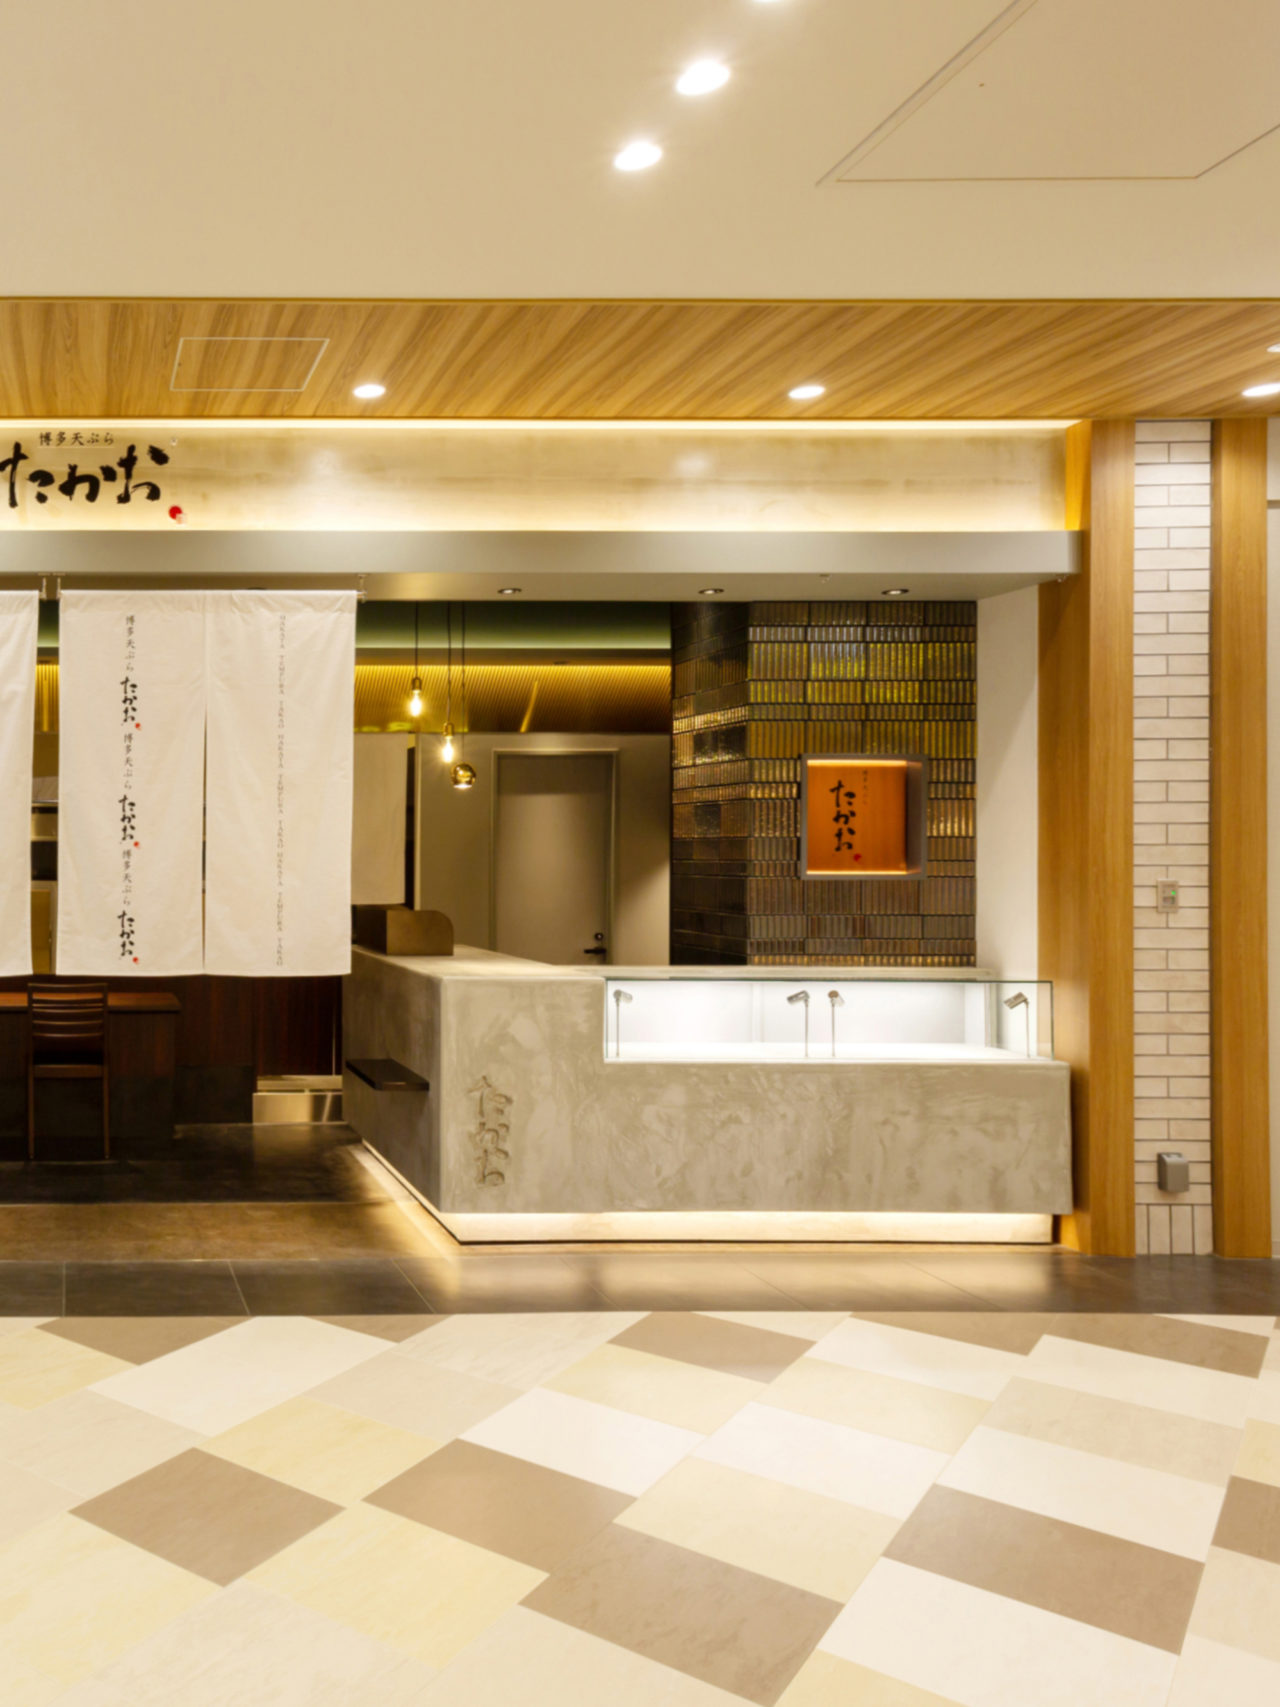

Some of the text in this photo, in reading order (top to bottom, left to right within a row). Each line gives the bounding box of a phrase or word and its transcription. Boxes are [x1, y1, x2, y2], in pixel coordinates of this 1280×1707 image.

[38, 431, 116, 448] 博多天ぷら
[120, 676, 138, 723] たかお
[118, 794, 136, 841] たかお
[829, 780, 856, 852] たかお
[117, 910, 135, 956] たかお
